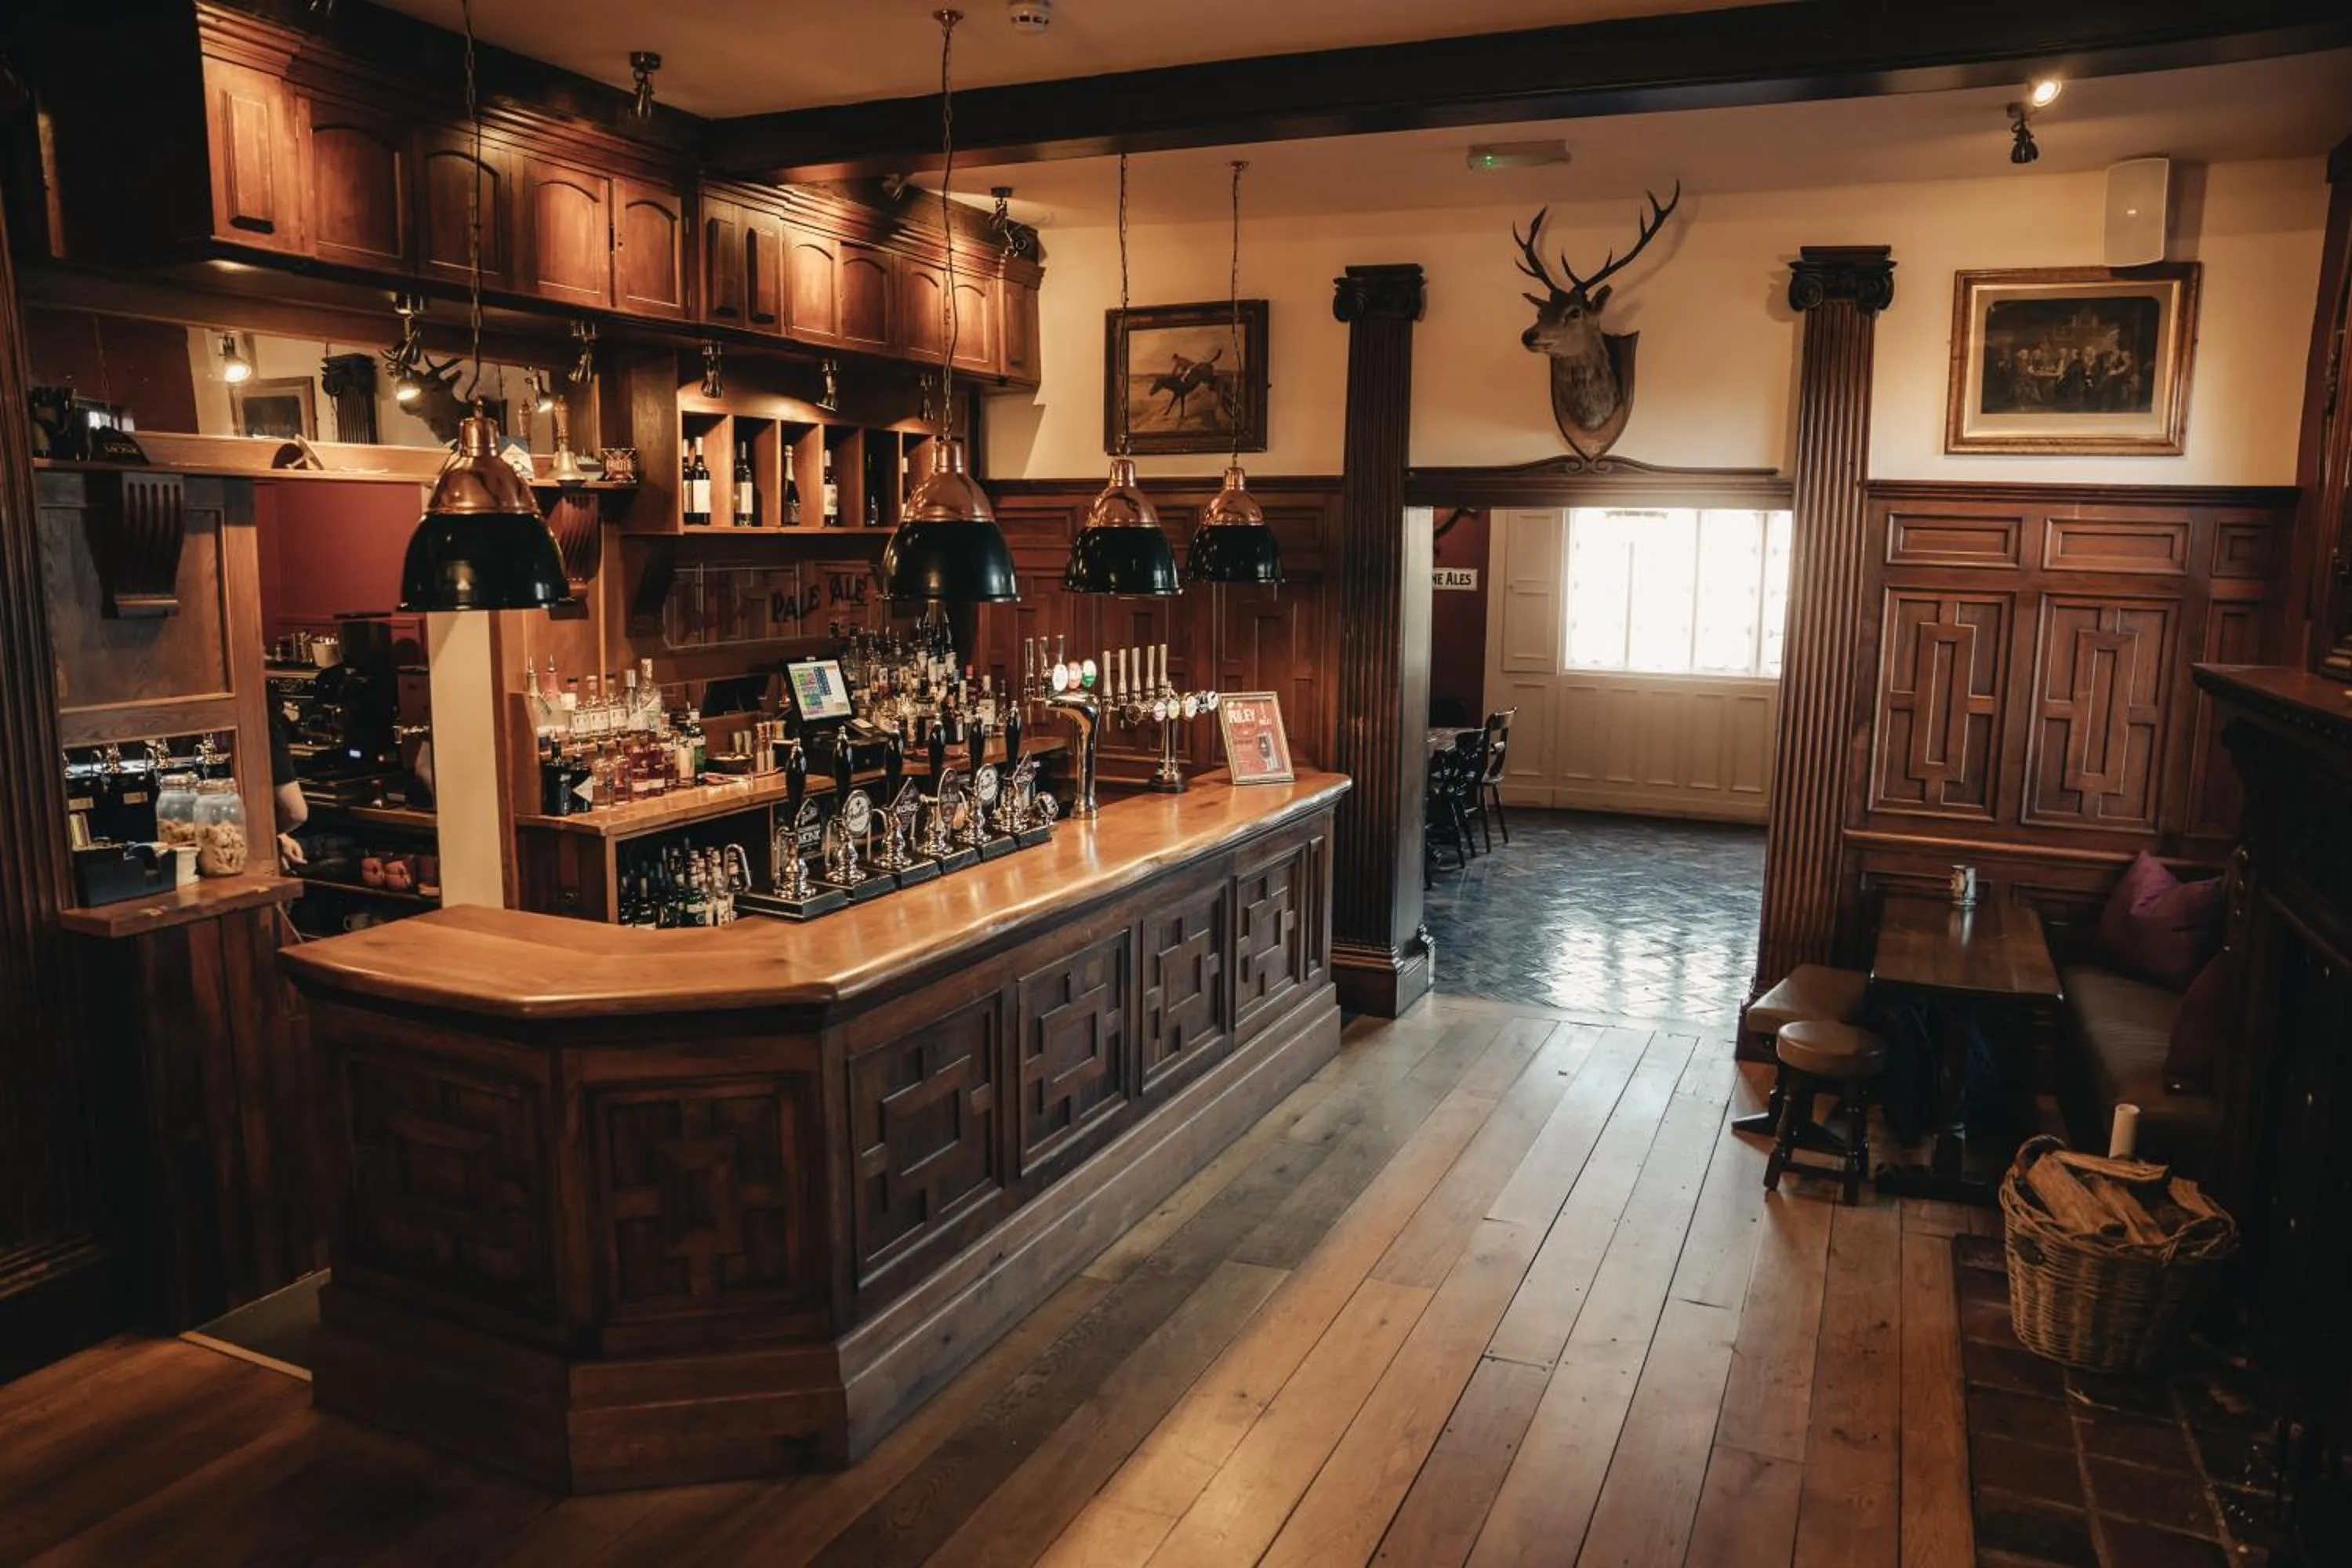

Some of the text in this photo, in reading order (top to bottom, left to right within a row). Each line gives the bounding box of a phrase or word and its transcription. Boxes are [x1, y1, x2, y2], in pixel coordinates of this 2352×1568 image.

[1446, 572, 1472, 586] ALES
[771, 572, 869, 622] PALE ALE
